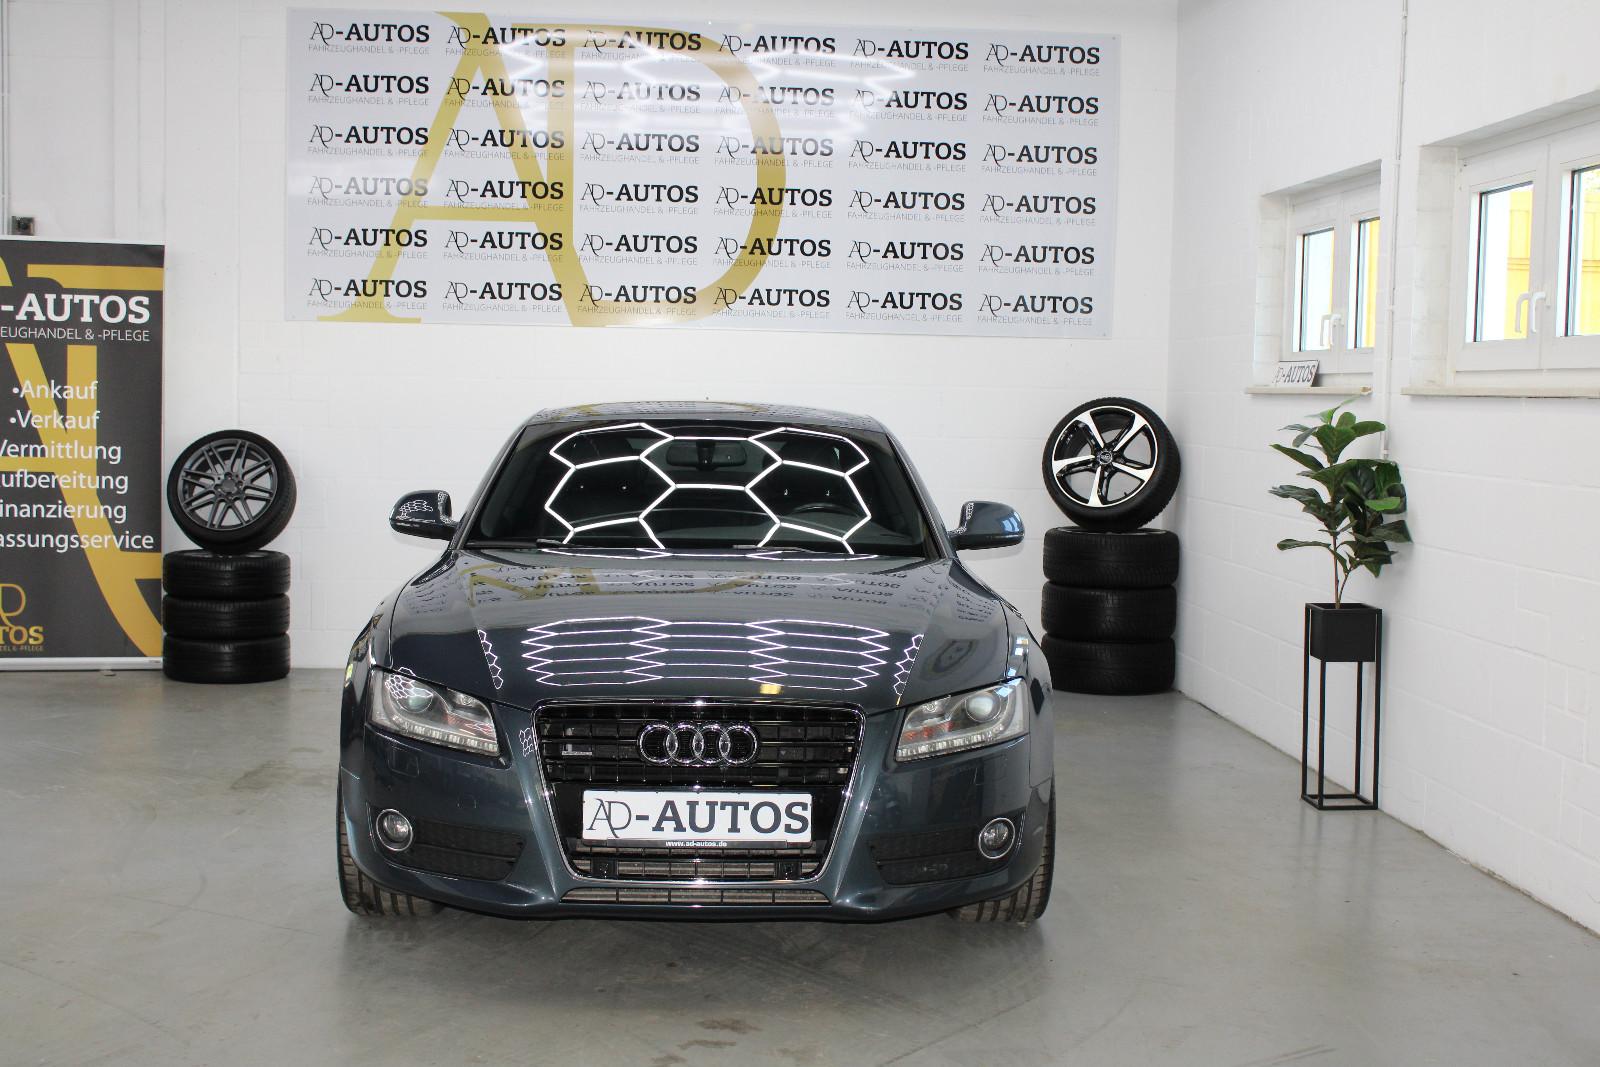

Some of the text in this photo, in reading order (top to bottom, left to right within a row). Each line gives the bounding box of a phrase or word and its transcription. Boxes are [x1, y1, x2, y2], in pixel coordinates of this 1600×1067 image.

[311, 22, 430, 46] AD-AUTOS
[448, 26, 566, 50] AD-AUTOS
[718, 34, 836, 58] AD-AUTOS
[852, 38, 969, 62] AD-AUTOS
[986, 43, 1100, 66] AD-AUTOS
[310, 73, 429, 97] AD-AUTOS
[447, 77, 566, 101] AD-AUTOS
[851, 89, 967, 112] AD-AUTOS
[984, 93, 1099, 117] AD-AUTOS
[310, 124, 429, 149] AD-AUTOS
[446, 128, 565, 152] AD-AUTOS
[581, 131, 700, 155] AD-AUTOS
[716, 135, 834, 159] AD-AUTOS
[849, 139, 966, 163] AD-AUTOS
[982, 144, 1098, 167] AD-AUTOS
[309, 176, 428, 200] AD-AUTOS
[445, 179, 564, 203] AD-AUTOS
[580, 182, 699, 206] AD-AUTOS
[715, 186, 833, 210] AD-AUTOS
[848, 190, 965, 213] AD-AUTOS
[981, 194, 1096, 217] AD-AUTOS
[309, 227, 427, 251] AD-AUTOS
[445, 230, 563, 254] AD-AUTOS
[580, 233, 698, 257] AD-AUTOS
[714, 236, 831, 260] AD-AUTOS
[847, 240, 964, 263] AD-AUTOS
[980, 244, 1095, 267] AD-AUTOS
[309, 278, 427, 302] AD-AUTOS
[444, 281, 562, 304] AD-AUTOS
[579, 284, 697, 307] AD-AUTOS
[713, 287, 830, 310] AD-AUTOS
[847, 290, 962, 314] AD-AUTOS
[979, 294, 1093, 317] AD-AUTOS
[85, 328, 94, 340] &
[98, 330, 150, 342] -PFLEGE
[1272, 364, 1316, 384] D-AUTOS
[0, 468, 128, 494] ufbereitung
[586, 798, 809, 838] AD-AUTOS
